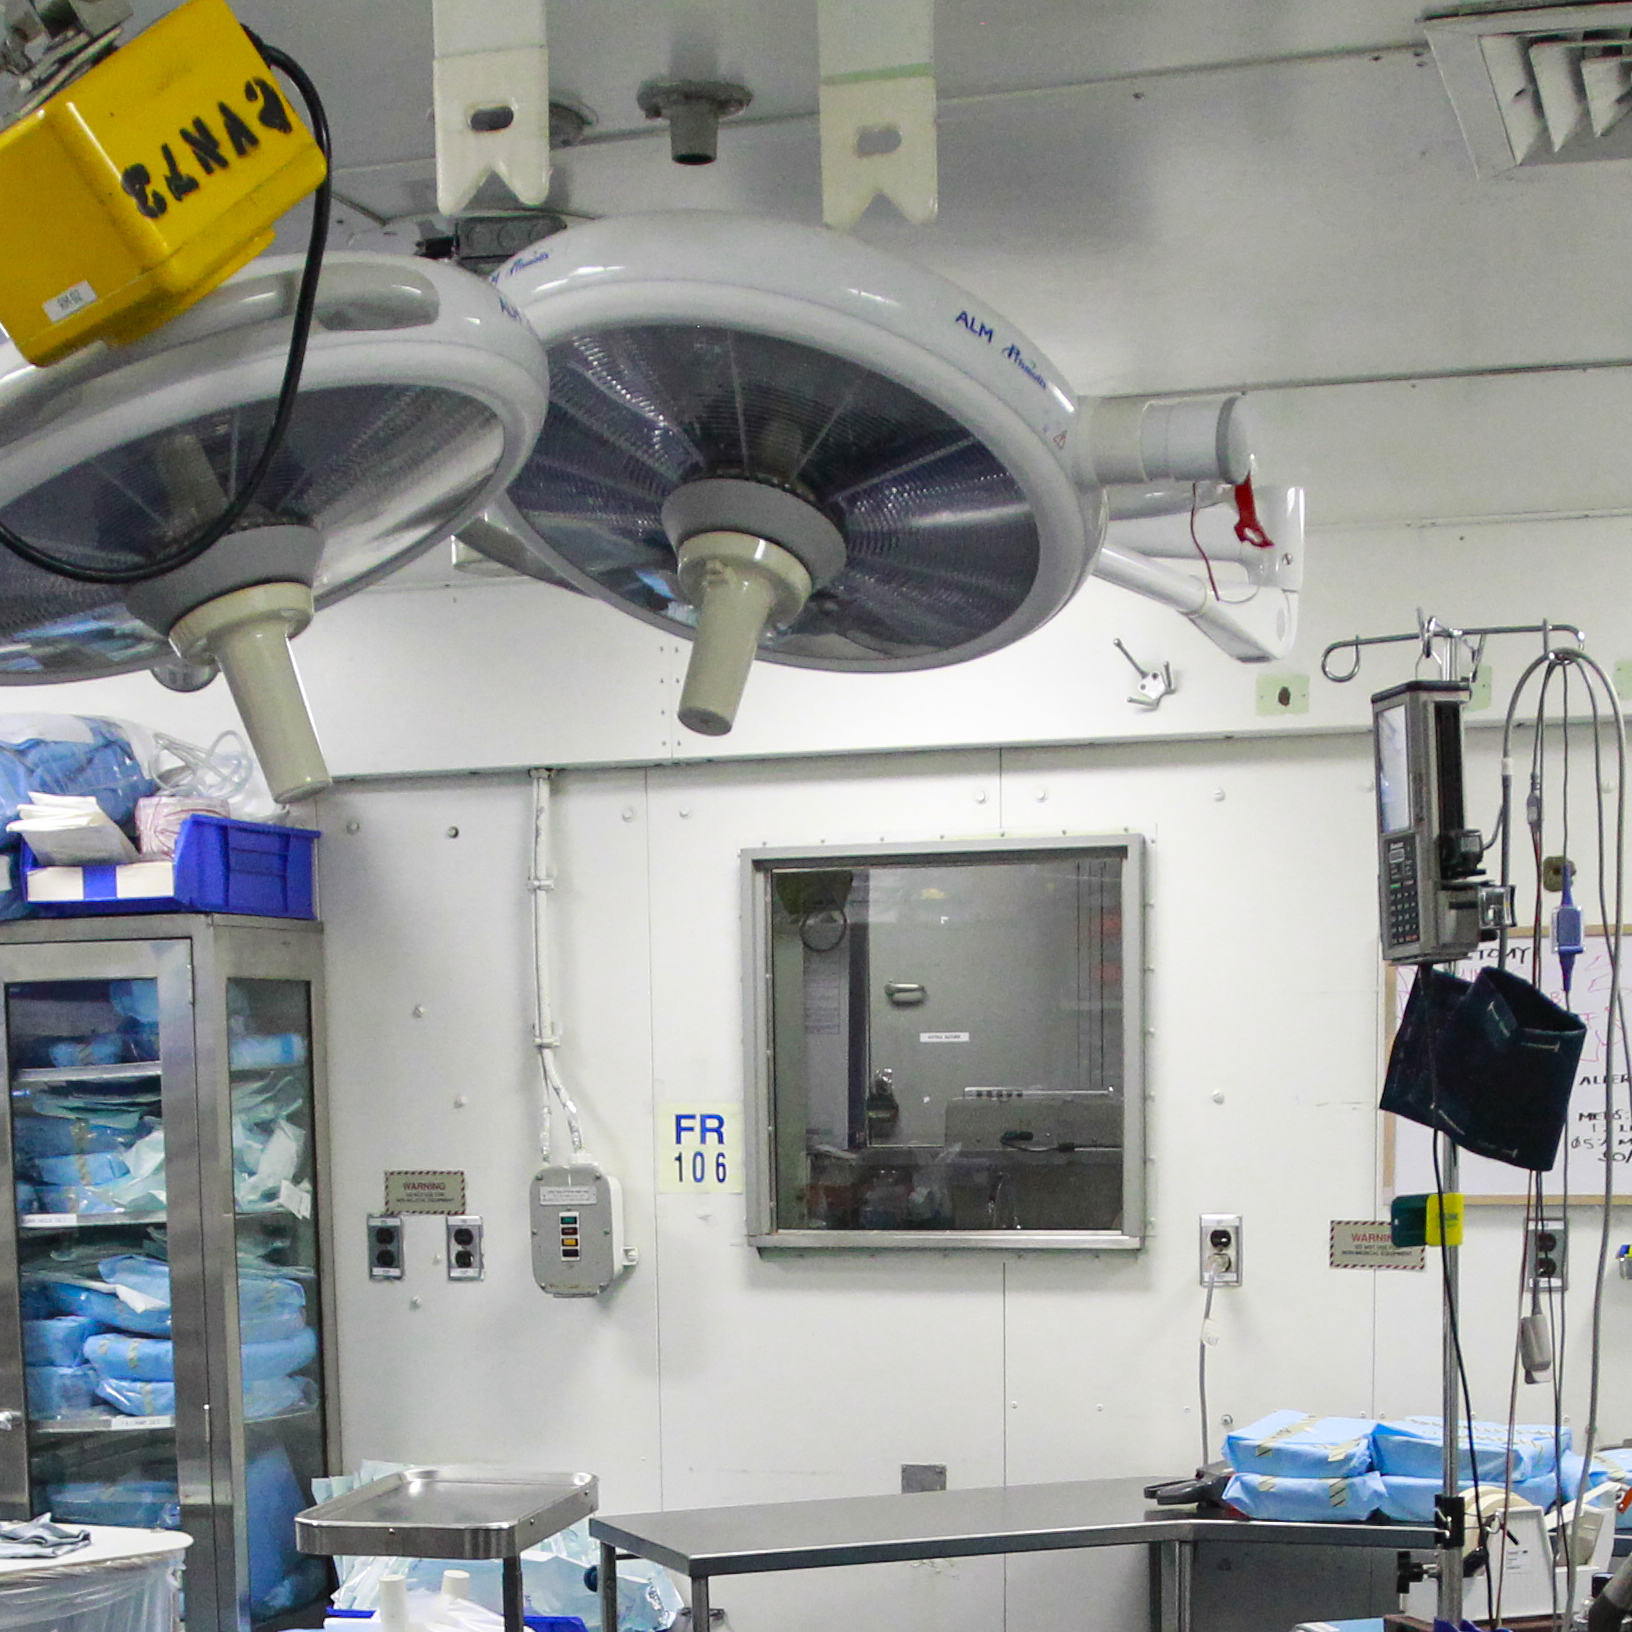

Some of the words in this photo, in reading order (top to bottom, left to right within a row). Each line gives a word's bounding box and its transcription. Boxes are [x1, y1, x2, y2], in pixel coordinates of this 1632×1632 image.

[955, 310, 994, 343] ALM
[674, 1113, 726, 1145] FR
[673, 1151, 727, 1183] 106
[403, 1182, 446, 1191] WARNING
[1352, 1233, 1393, 1243] WARNIN
